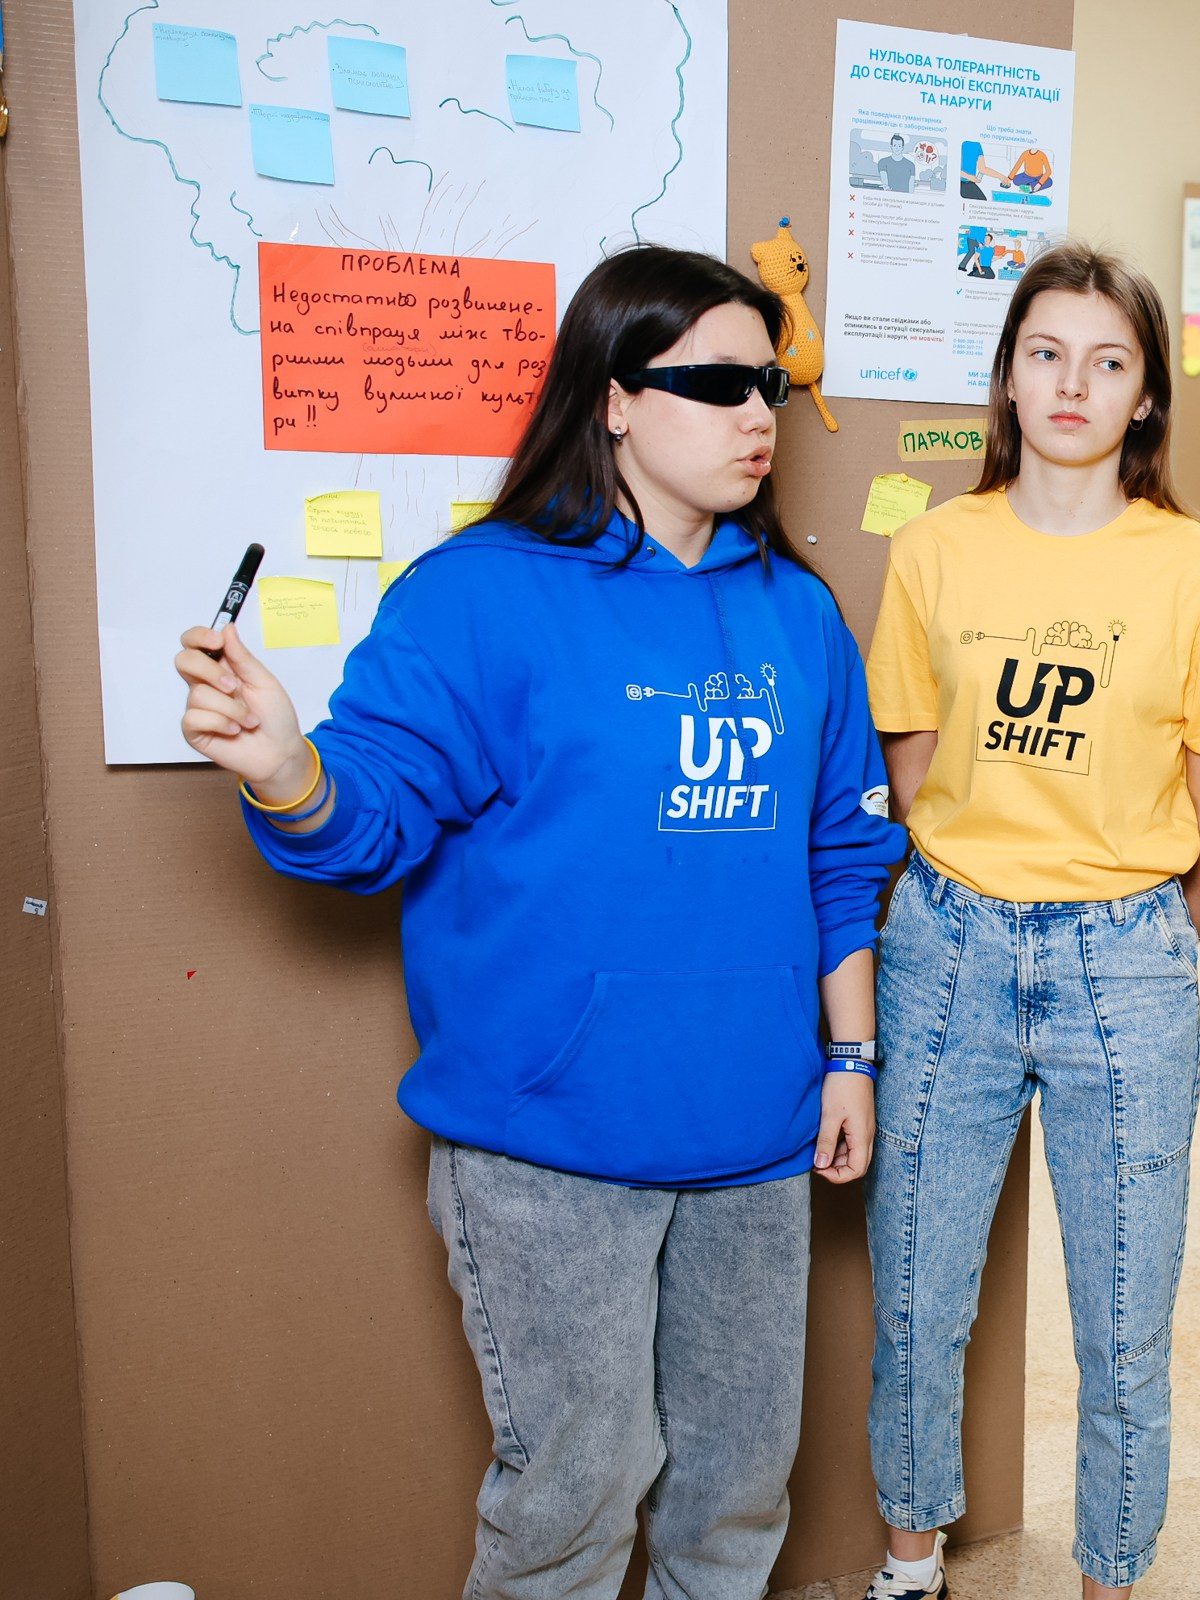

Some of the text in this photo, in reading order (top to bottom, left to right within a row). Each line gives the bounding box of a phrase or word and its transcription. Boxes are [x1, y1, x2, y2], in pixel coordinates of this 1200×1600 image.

[869, 48, 1041, 81] НУЛЬОВА ТОЛЕРАНТНІСТЬ
[850, 65, 1061, 103] ДО СЕКСУАЛЬНОЇ ЕКСПЛУАТАЦІЇ
[920, 91, 992, 111] ТА НАРУГИ
[341, 254, 461, 278] ПРОБЛЕМА
[270, 318, 295, 334] на
[314, 312, 420, 345] співпраця
[438, 320, 488, 341] між
[844, 313, 862, 321] Якщо
[872, 315, 890, 323] стали
[891, 317, 919, 325] свідками
[844, 322, 877, 330] опинились
[884, 324, 908, 334] ситуації
[909, 326, 945, 335] сексуальної
[844, 331, 883, 339] експлуатації
[467, 357, 504, 384] для
[860, 367, 901, 381] unicef
[272, 374, 535, 414] витку вуличної культ
[273, 413, 297, 436] ри
[996, 657, 1095, 724] UP
[679, 714, 773, 781] UP
[984, 720, 1086, 761] SHIFT
[666, 784, 770, 819] SHIFT
